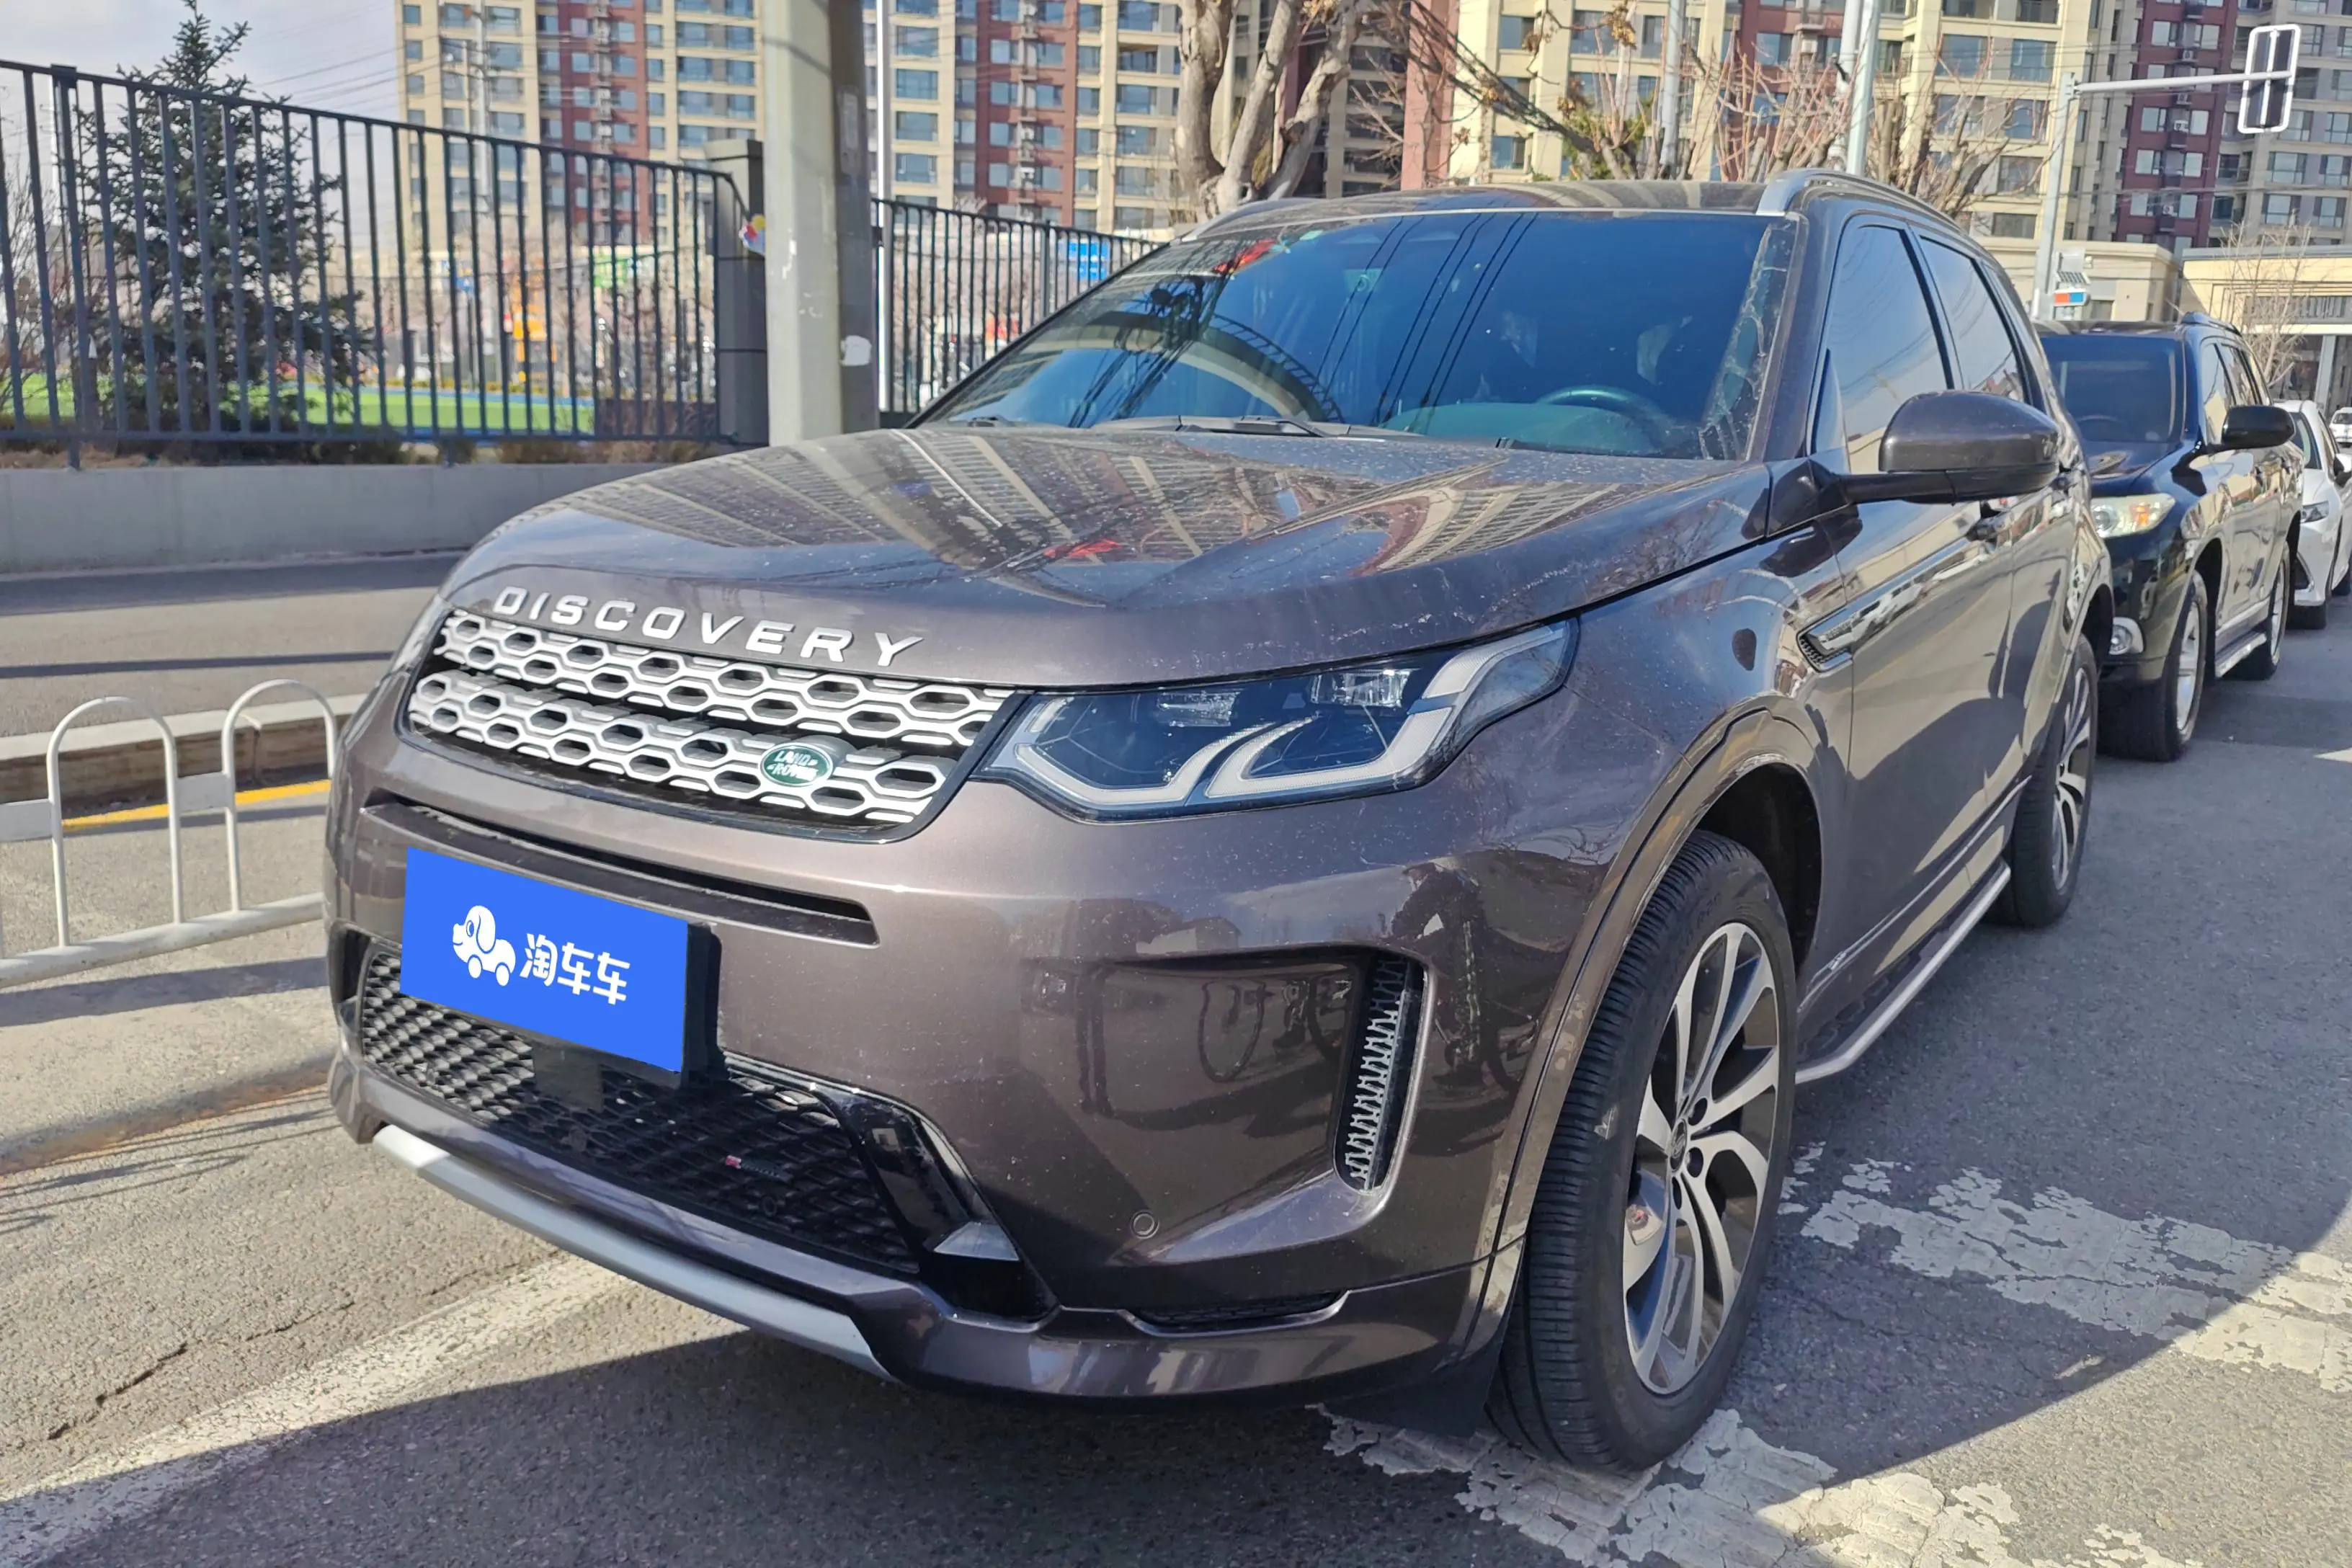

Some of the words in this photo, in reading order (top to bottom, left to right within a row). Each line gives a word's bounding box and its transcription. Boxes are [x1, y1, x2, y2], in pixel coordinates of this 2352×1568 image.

[493, 586, 923, 667] DISCOVERY
[774, 750, 811, 767] LAND
[772, 762, 819, 782] ROV
